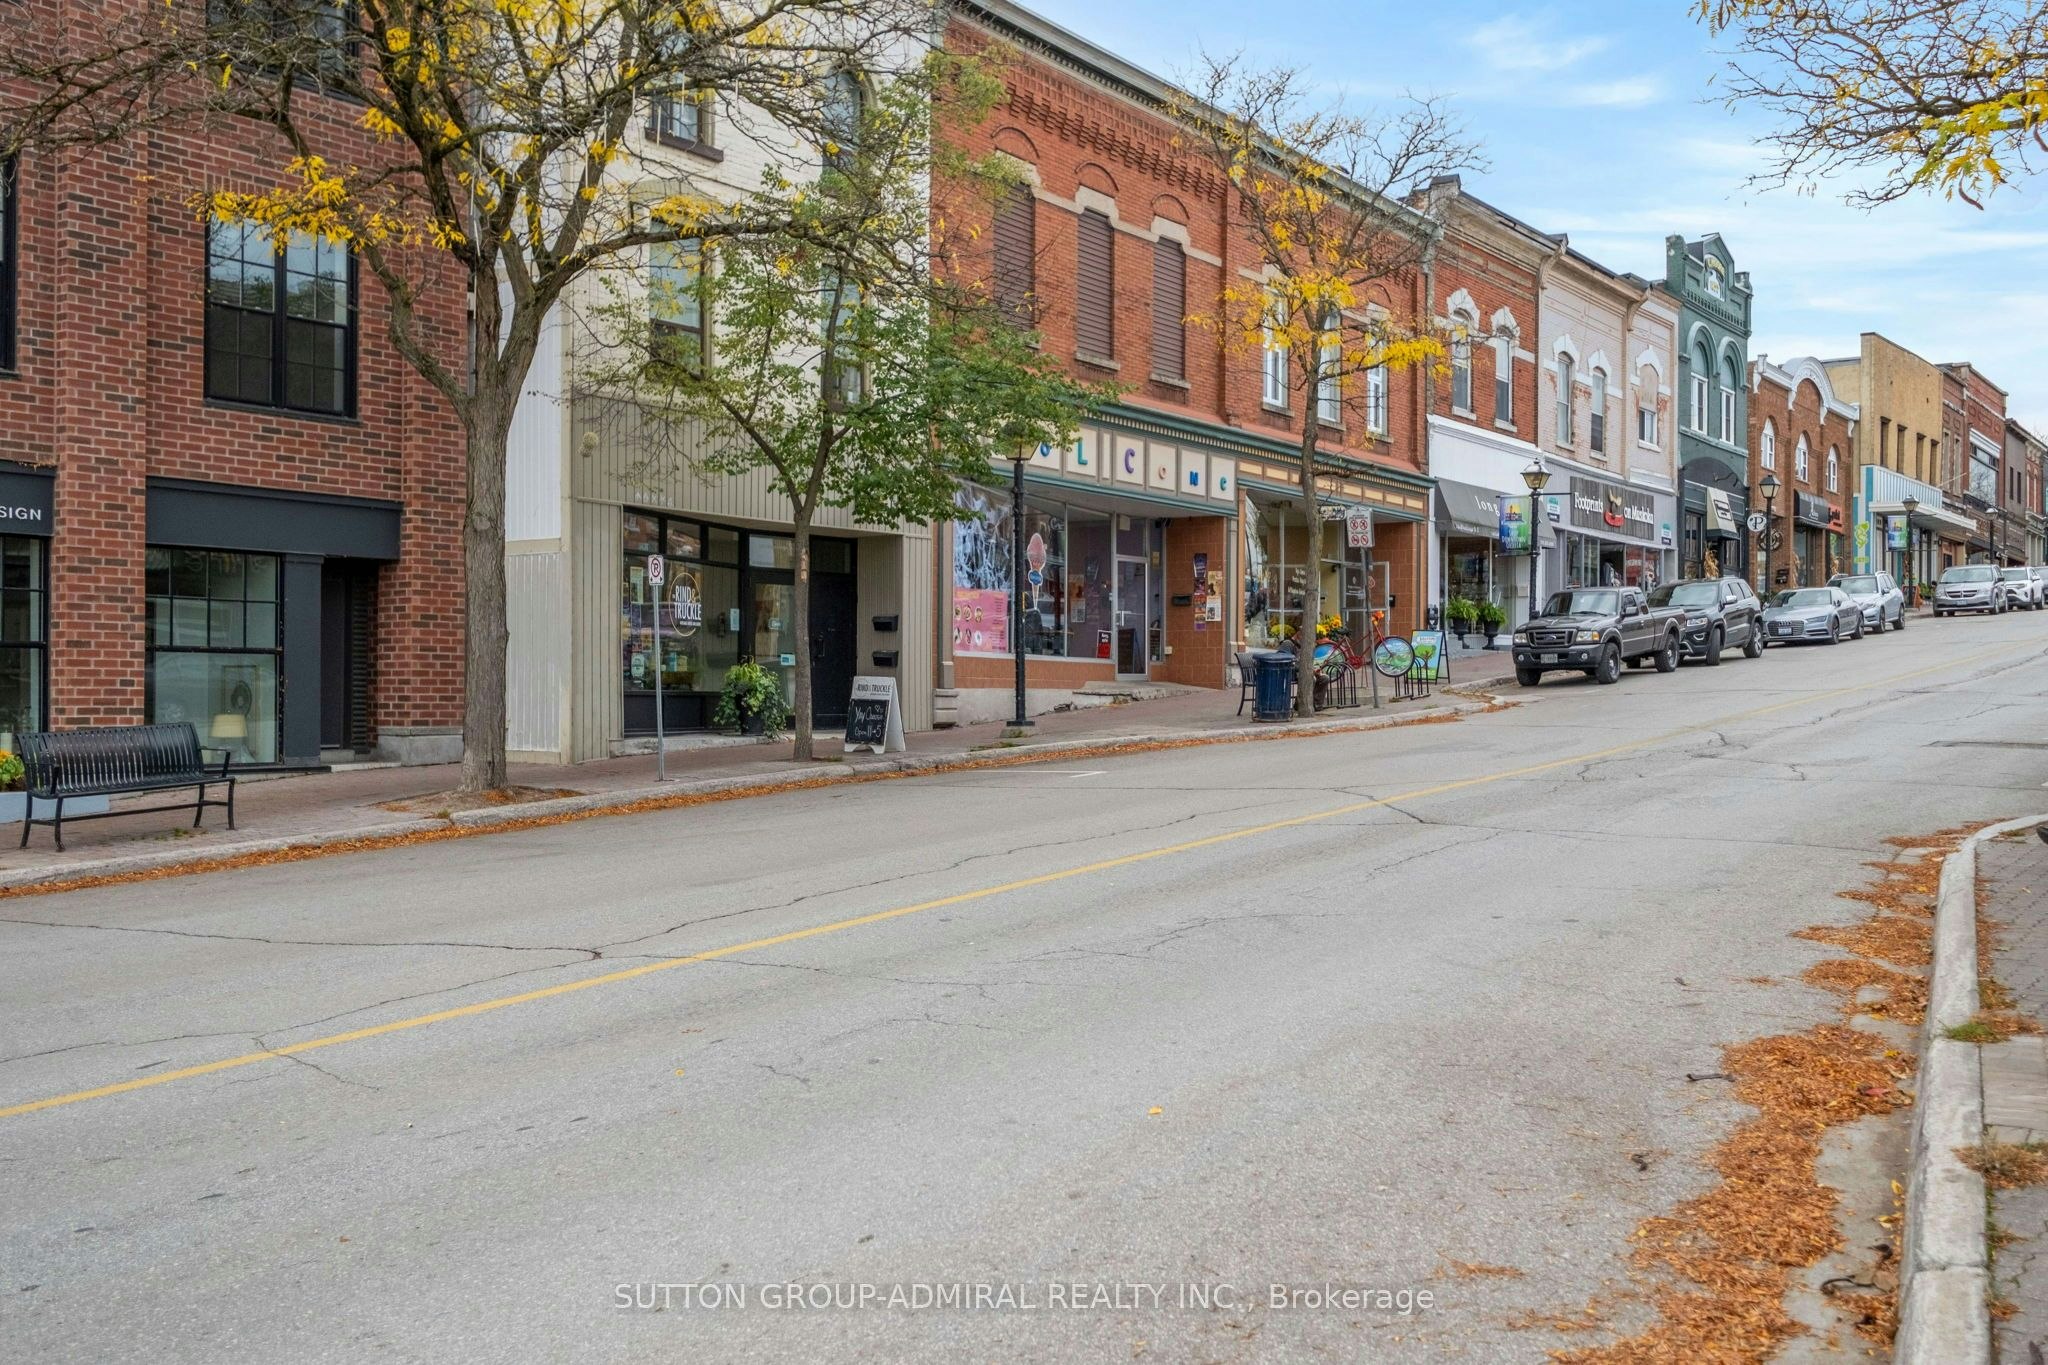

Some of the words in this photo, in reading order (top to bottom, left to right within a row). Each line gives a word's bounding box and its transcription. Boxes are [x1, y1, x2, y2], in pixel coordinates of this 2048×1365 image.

[0, 505, 41, 521] SIGN
[1574, 491, 1604, 514] Footprints
[1631, 504, 1654, 525] Muskoka
[675, 585, 692, 603] RIND
[673, 602, 702, 621] TRUCKLE
